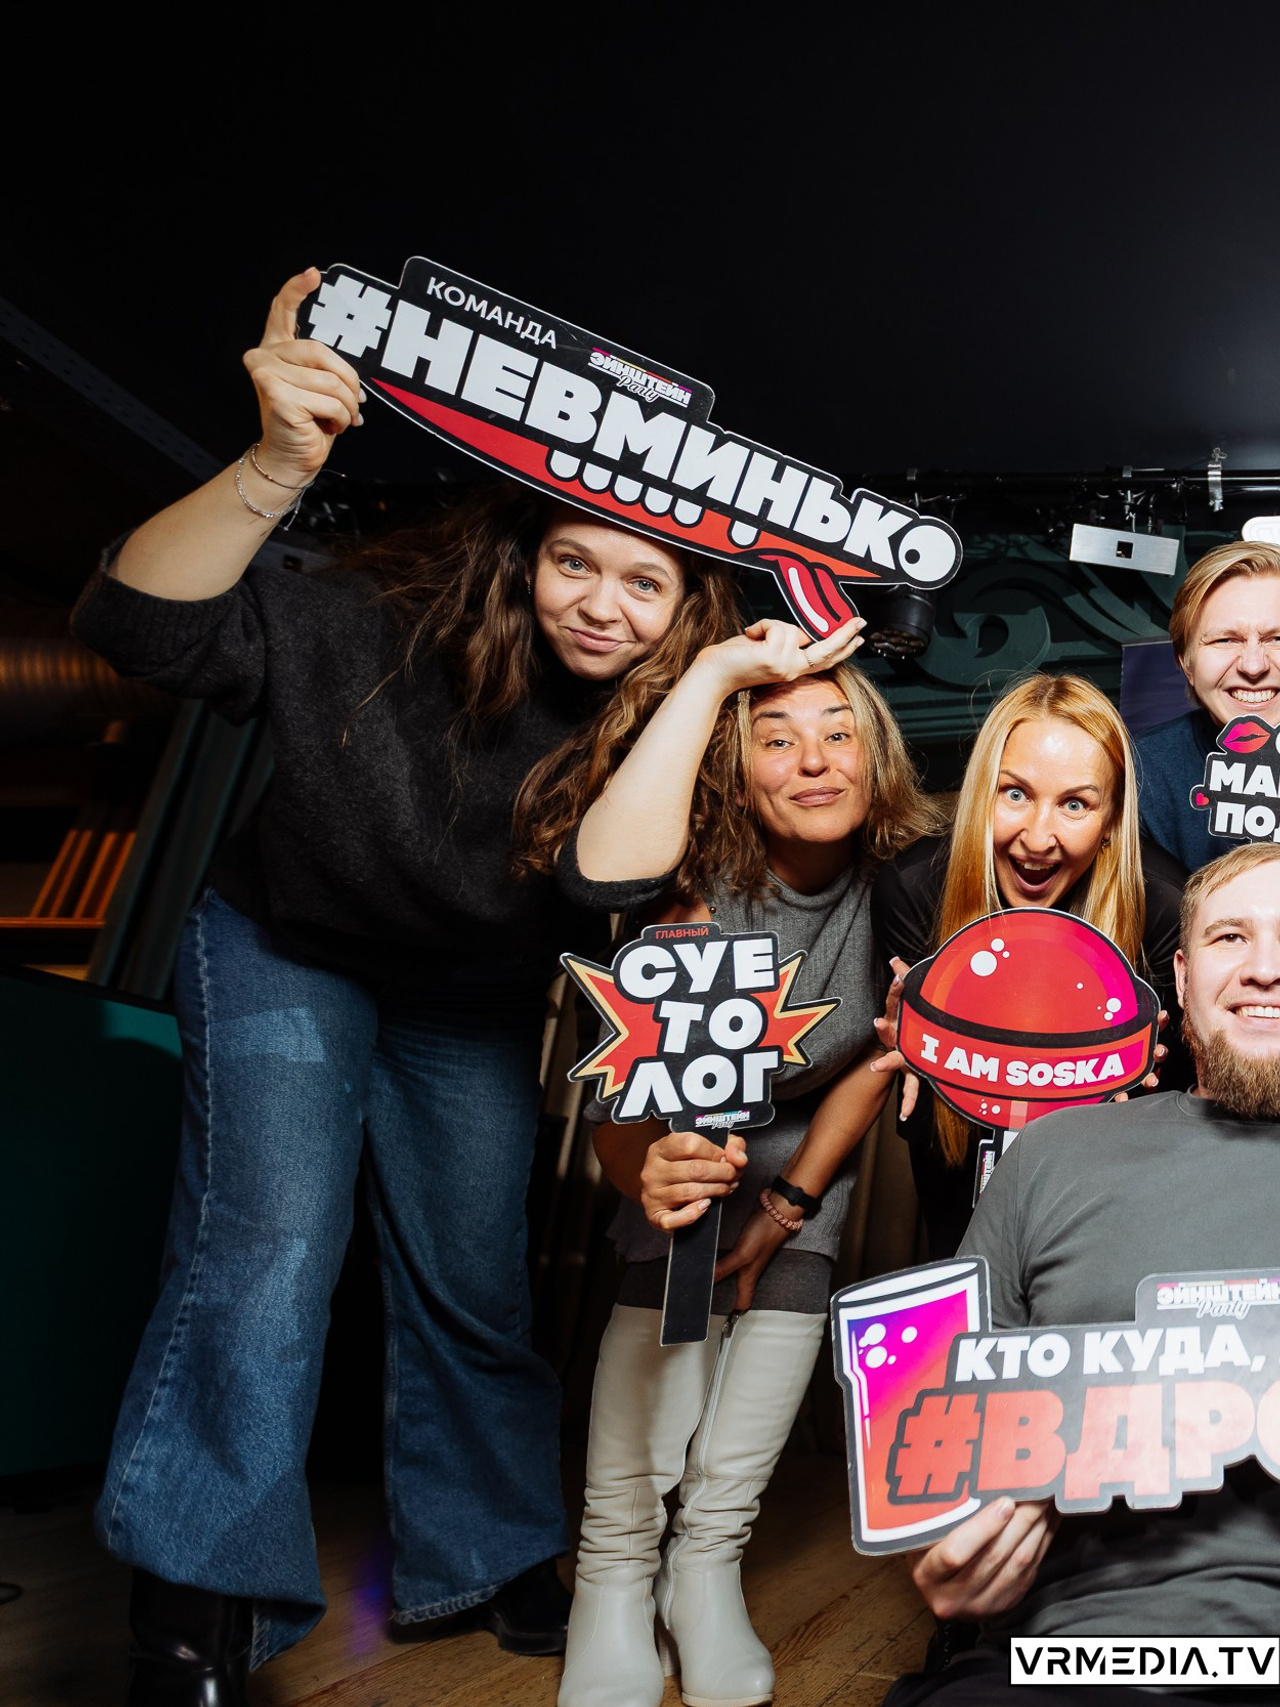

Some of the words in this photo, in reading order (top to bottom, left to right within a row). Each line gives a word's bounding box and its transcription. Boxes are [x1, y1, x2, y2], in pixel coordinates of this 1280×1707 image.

[427, 277, 558, 350] КОМАНДА
[590, 352, 692, 405] ЭЙНШТЕЙН
[616, 374, 661, 403] Party
[309, 275, 957, 581] #НЕВМИНЬКО
[655, 926, 709, 939] ГЛАВНЫЙ
[620, 939, 774, 998] СУЕ
[659, 999, 762, 1053] ТО
[619, 1051, 778, 1117] ЛОГ
[921, 1034, 939, 1063] I
[944, 1047, 999, 1082] AM
[1006, 1053, 1124, 1086] SOSKA
[1196, 1300, 1251, 1320] Party
[955, 1333, 1070, 1382] КТО
[1083, 1324, 1266, 1376] КУДА,
